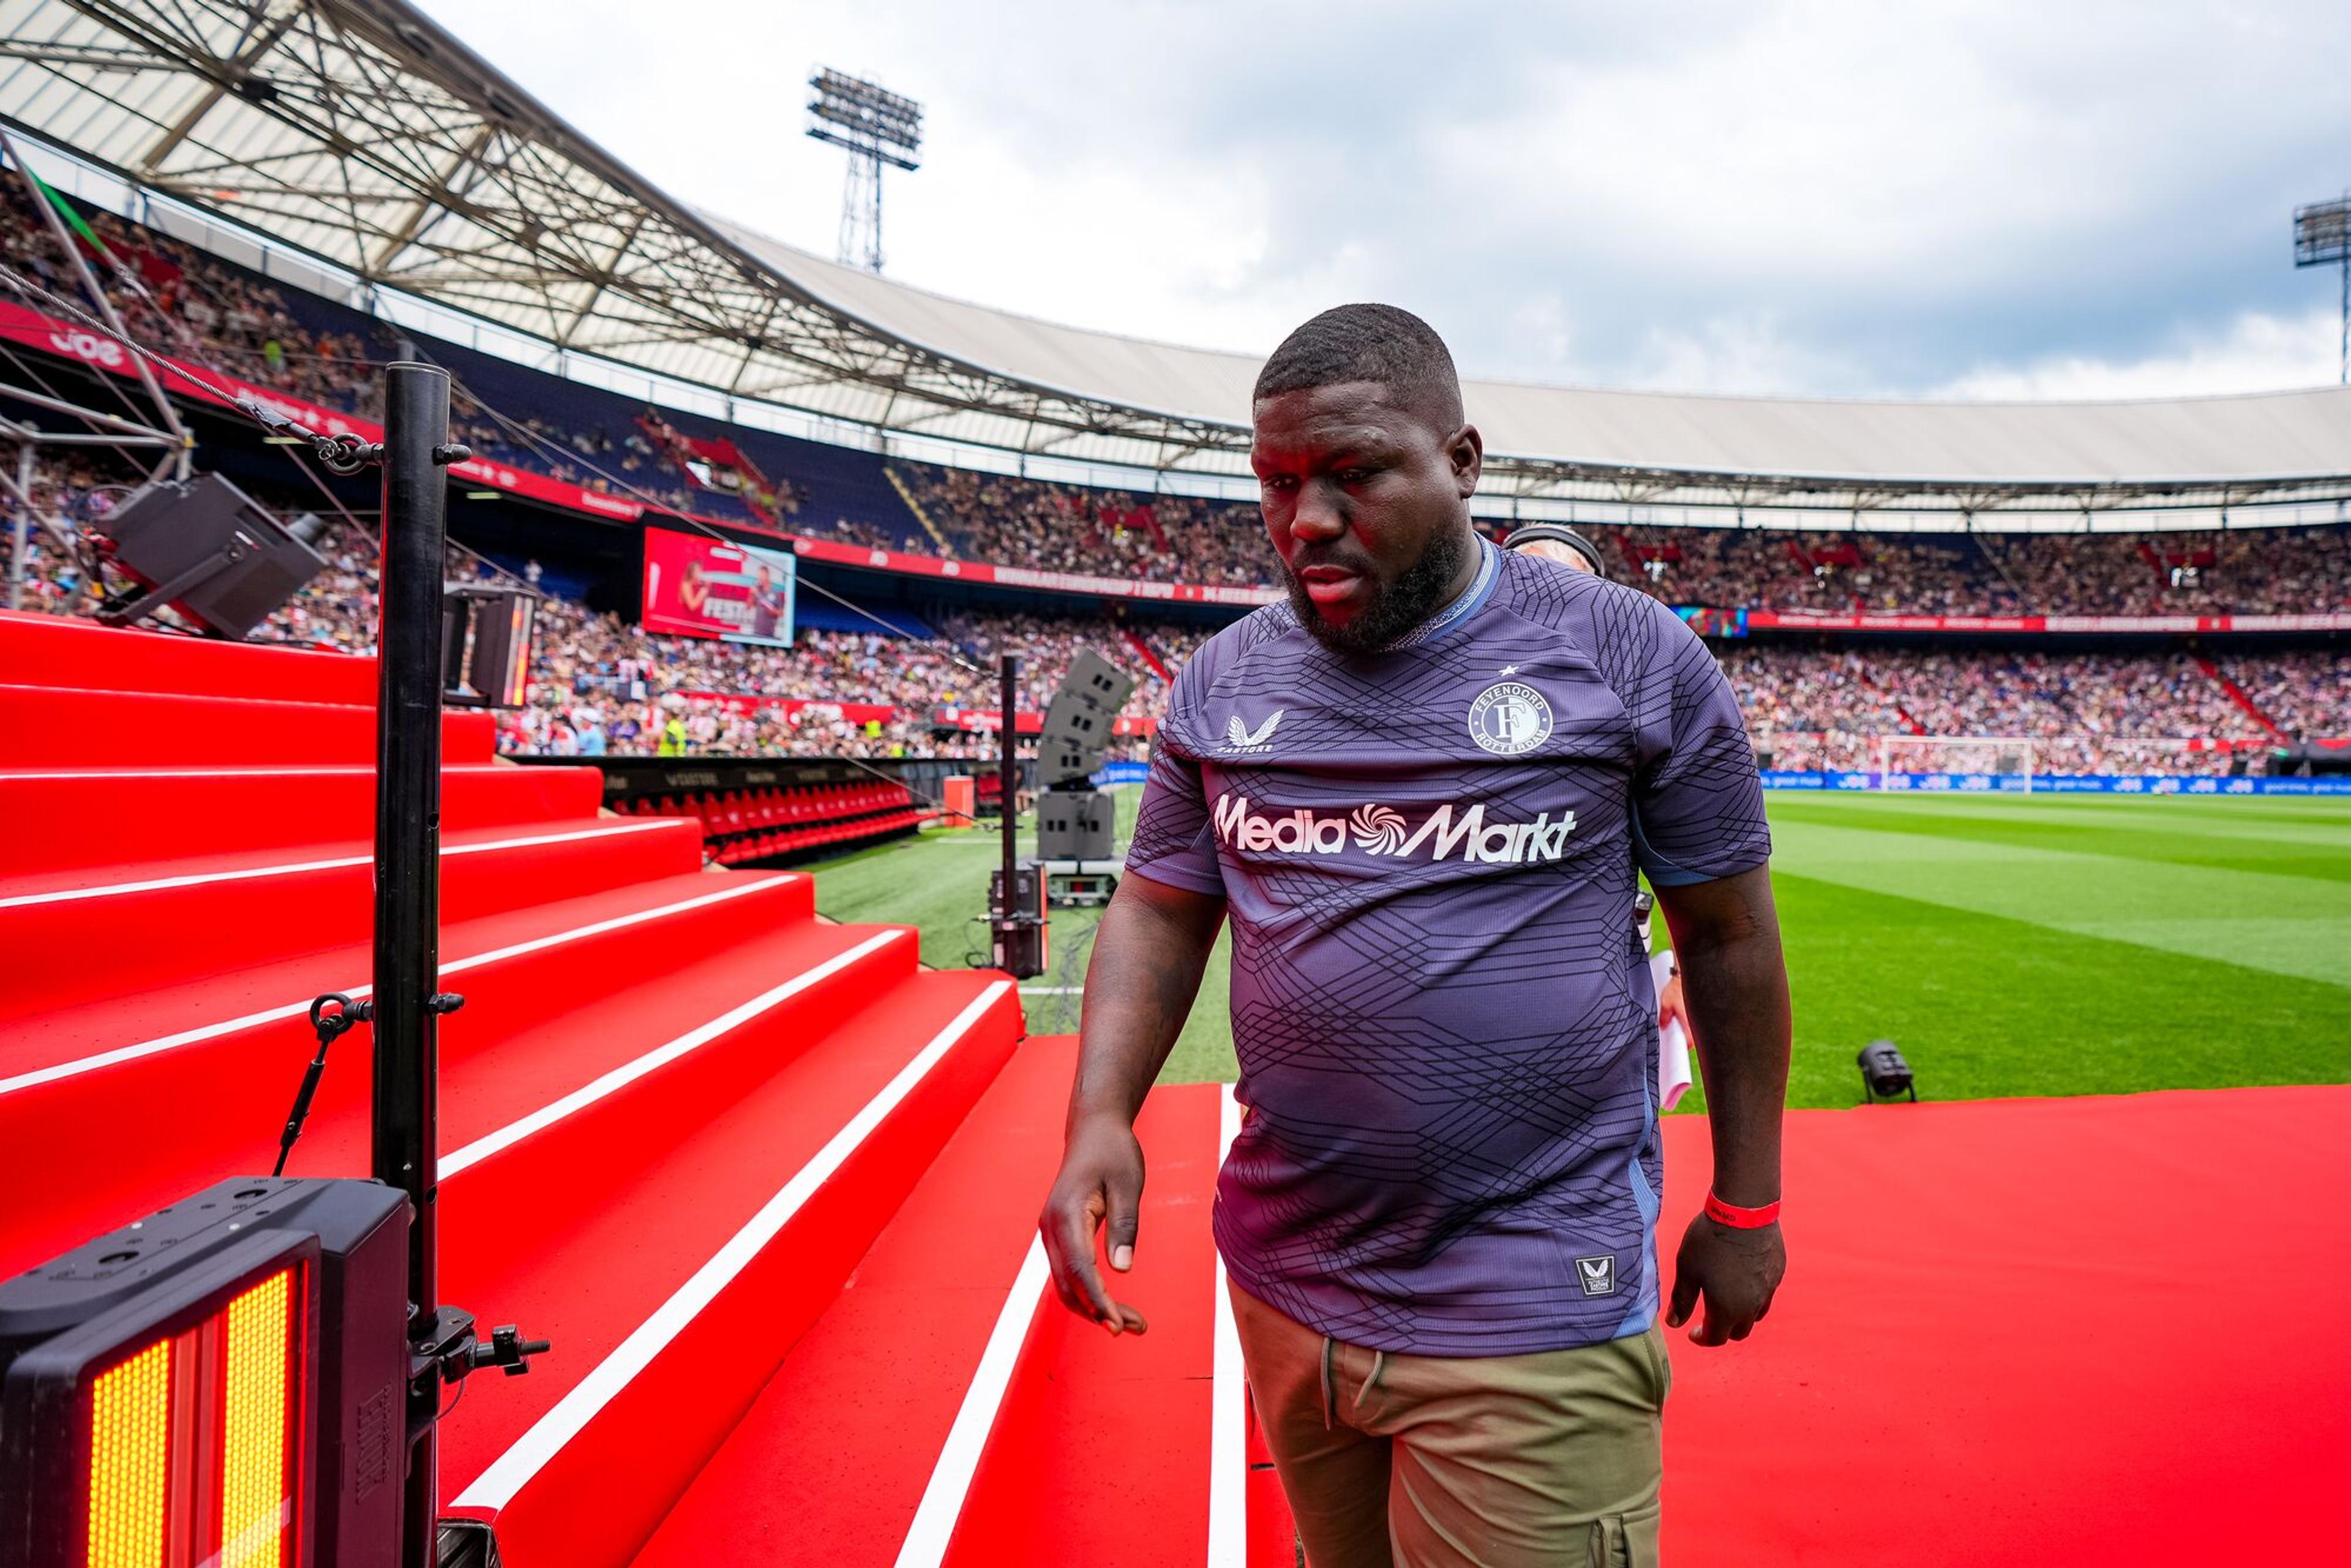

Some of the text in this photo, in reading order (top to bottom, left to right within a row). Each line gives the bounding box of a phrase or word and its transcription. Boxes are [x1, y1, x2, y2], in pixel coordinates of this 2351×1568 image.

[1475, 685, 1544, 713] FEYENOORD
[1493, 703, 1526, 739] F
[1476, 729, 1547, 752] ROTTERDAM
[1214, 794, 1577, 863] Media Markt
